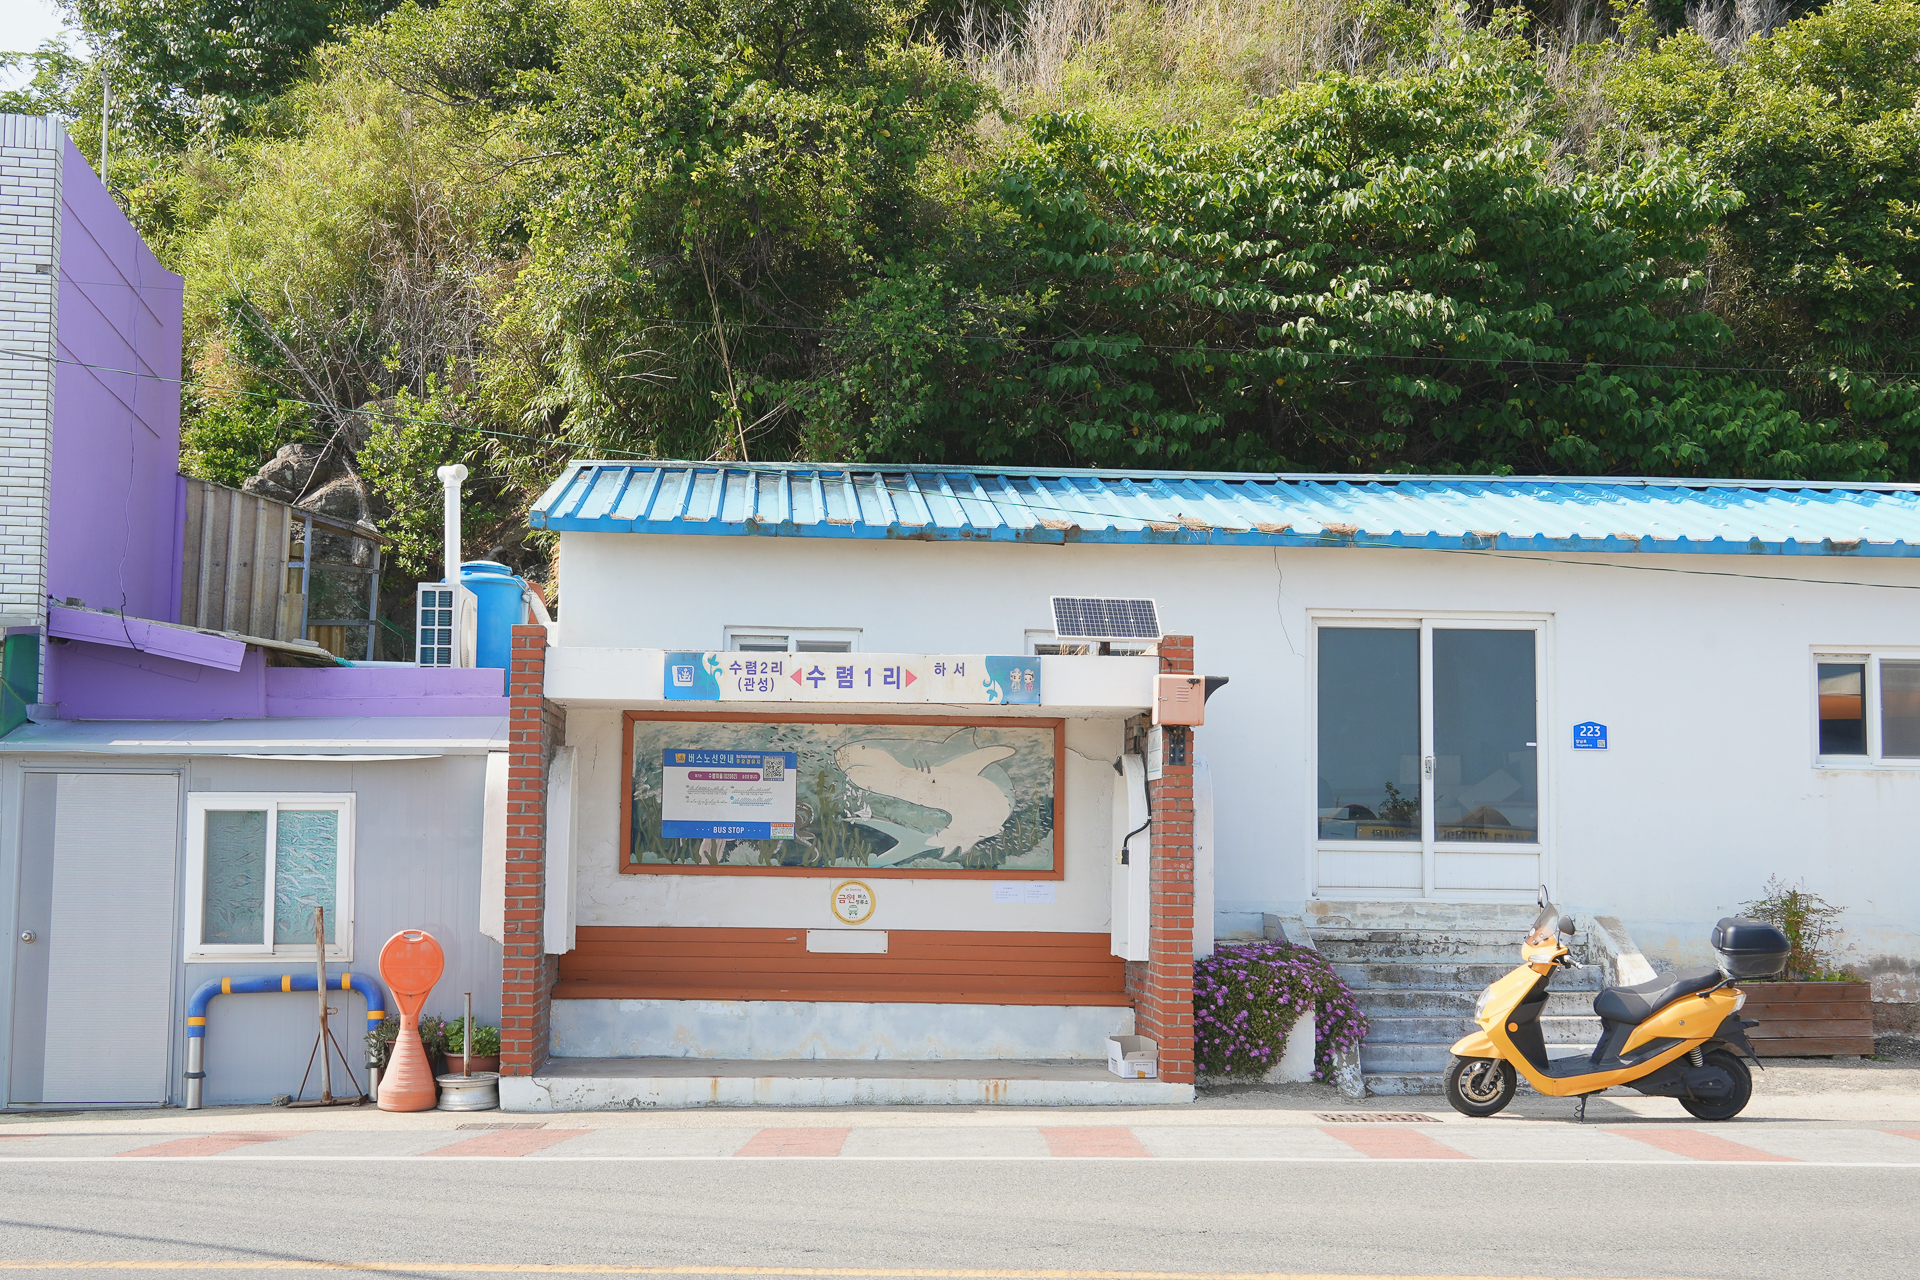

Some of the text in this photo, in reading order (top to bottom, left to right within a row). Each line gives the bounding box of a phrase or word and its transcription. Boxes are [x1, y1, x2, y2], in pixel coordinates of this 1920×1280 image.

[729, 661, 783, 676] 수렴2리
[934, 662, 965, 677] 하서
[806, 665, 901, 689] 수렴1리
[737, 677, 775, 692] (관성)
[1579, 725, 1601, 737] 223
[688, 753, 734, 764] 버스노선안내
[713, 826, 745, 834] BUS STOP
[838, 894, 856, 904] 금연
